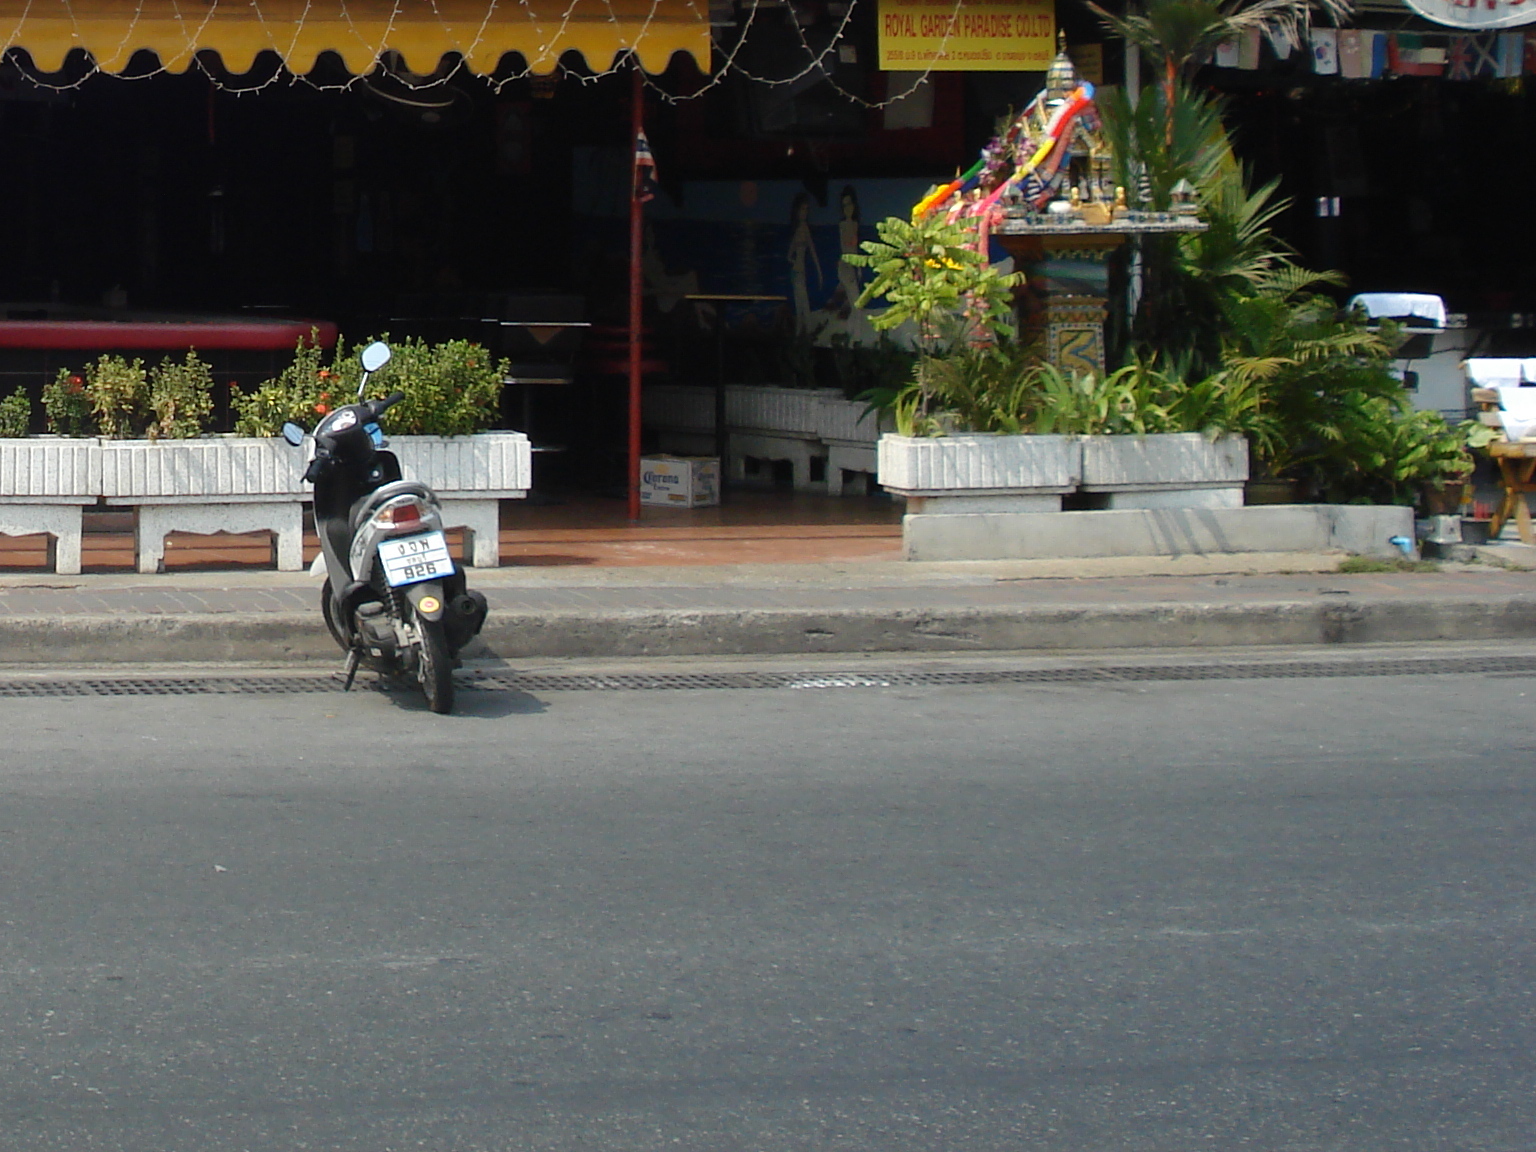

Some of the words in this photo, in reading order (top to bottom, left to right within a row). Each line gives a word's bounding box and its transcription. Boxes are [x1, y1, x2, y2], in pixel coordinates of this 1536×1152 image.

[885, 14, 917, 38] ROYAL
[921, 14, 961, 38] GARDEN
[965, 14, 1012, 38] PARADISE
[644, 471, 679, 485] Corona
[404, 563, 437, 579] 926
